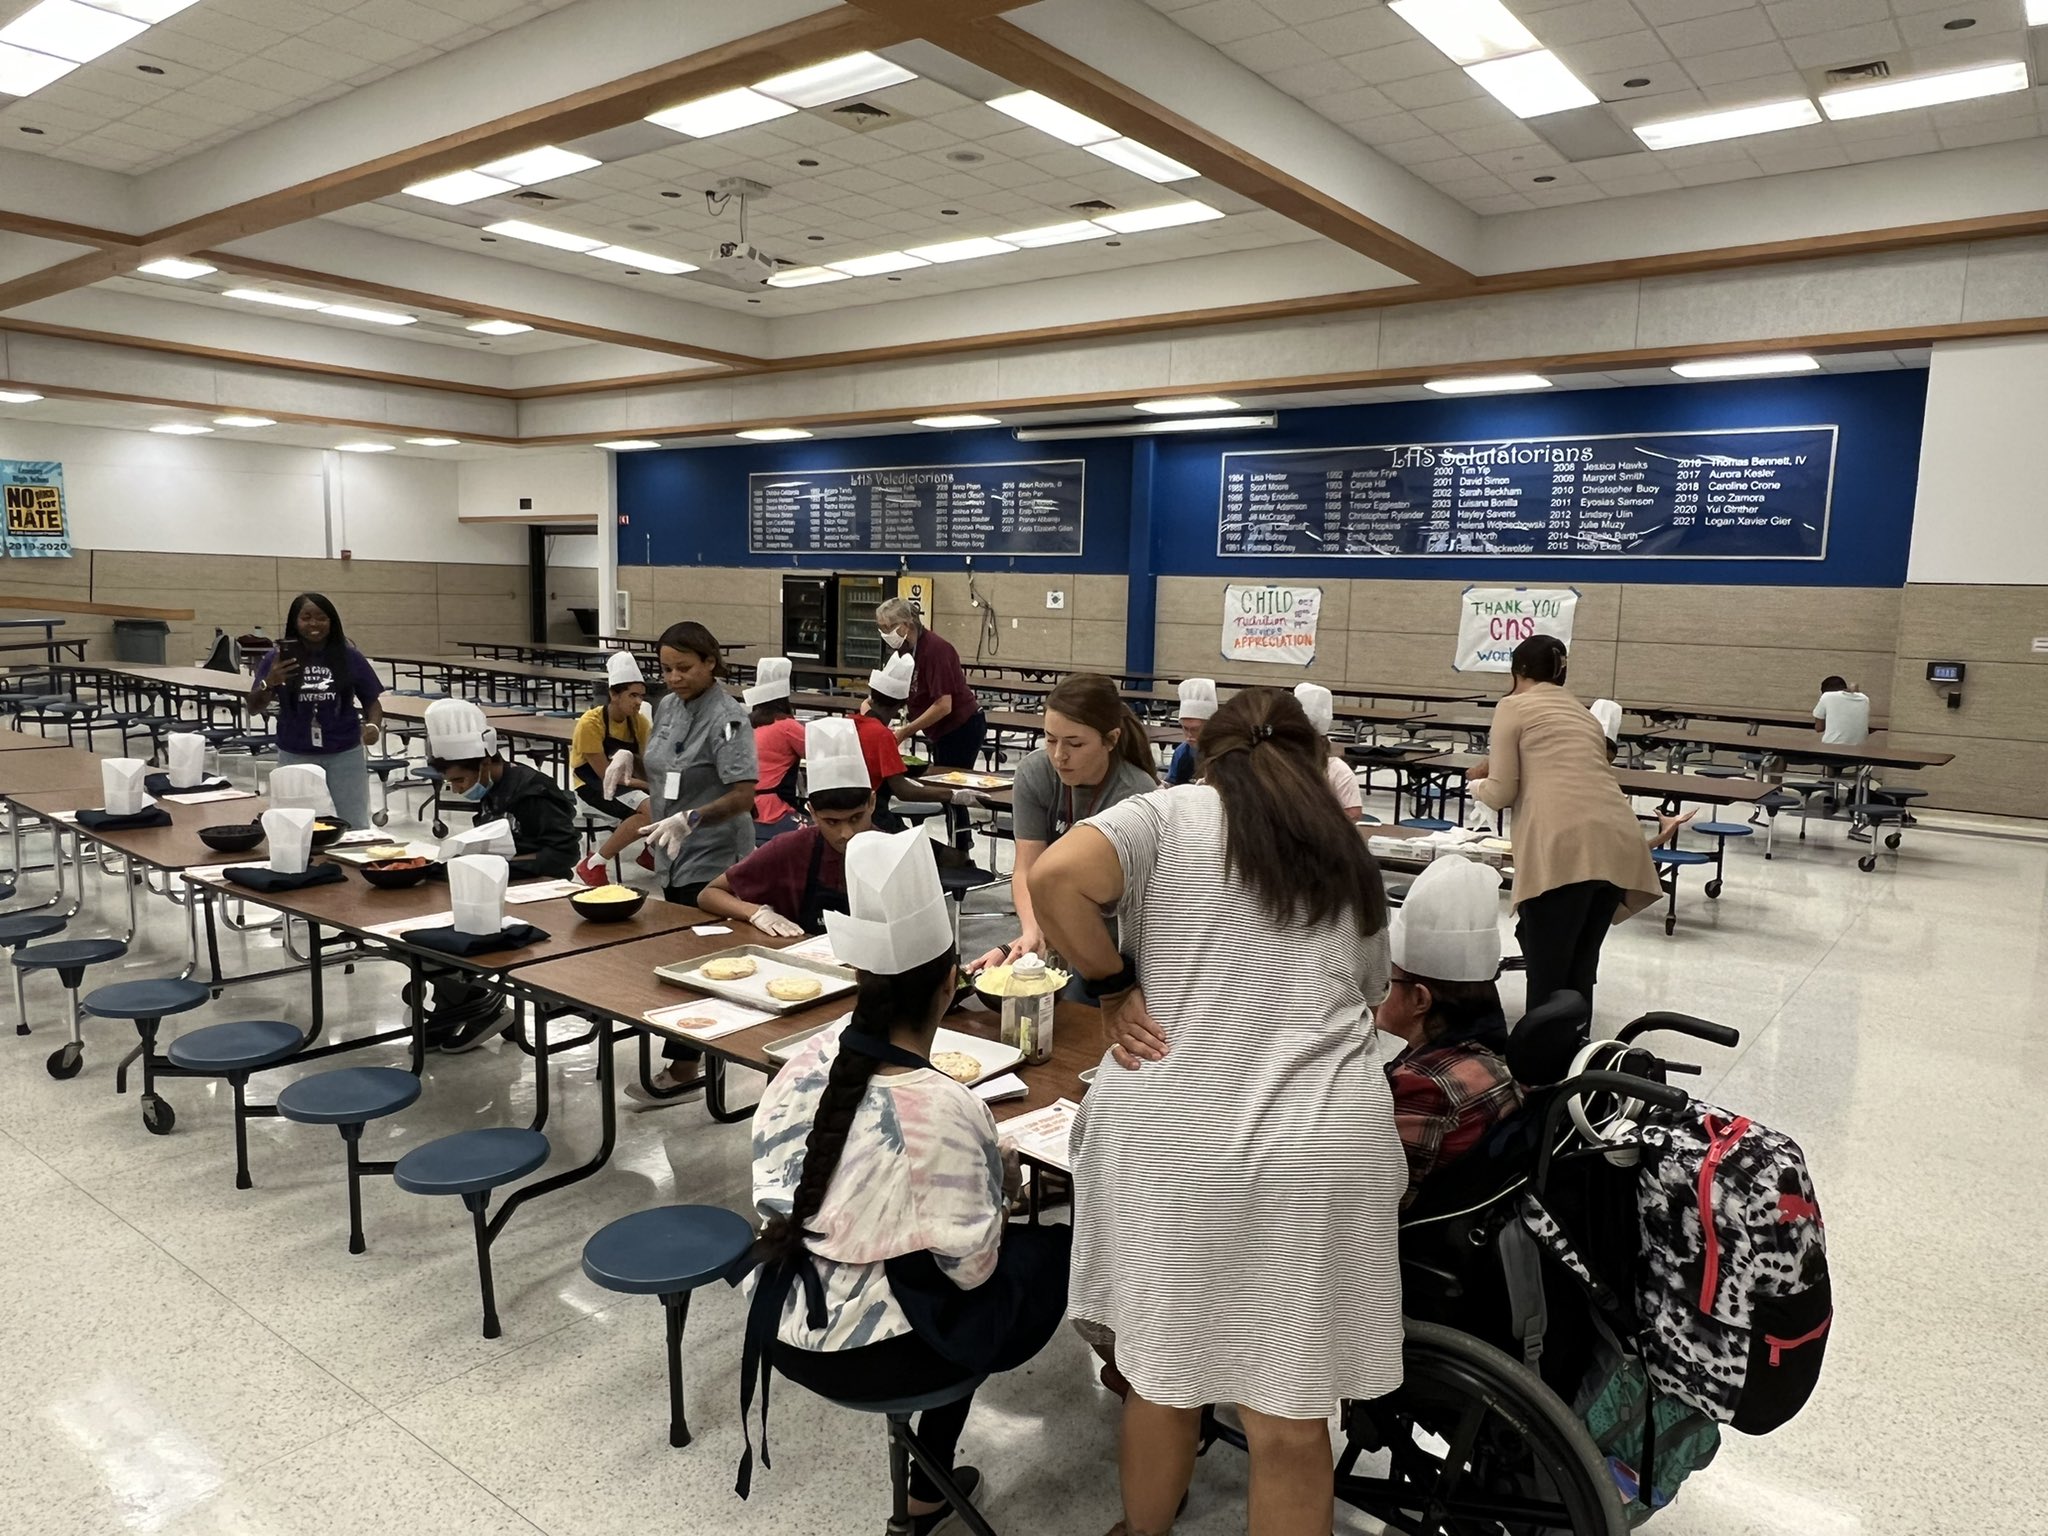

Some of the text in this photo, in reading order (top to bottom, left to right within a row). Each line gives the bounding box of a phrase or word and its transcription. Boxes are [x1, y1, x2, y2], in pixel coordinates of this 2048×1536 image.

[1392, 445, 1594, 468] LHS Salutatorians
[1553, 461, 1648, 472] 2008 Jessica Hawks
[1678, 456, 1807, 468] 2016 Thomas Bennett, IV
[1381, 469, 1398, 479] Frye
[1434, 466, 1491, 476] 2000 Tim Yip
[1677, 471, 1700, 480] 2017
[1709, 470, 1741, 479] Aurora
[876, 472, 954, 485] Valedictorians
[1251, 474, 1264, 482] Lisa
[1433, 476, 1510, 486] 2001 David Simon
[1552, 472, 1645, 483] 2009 Margret Smith
[1552, 486, 1574, 495] 2010
[1582, 485, 1633, 494] Christopher
[1676, 481, 1781, 491] 2018 Caroline Crone
[1432, 487, 1522, 497] 2002 Sarah Beckham
[7, 487, 34, 508] NO
[1550, 499, 1571, 507] 2011
[1617, 497, 1654, 506] Samson
[1675, 493, 1765, 503] 2019 Leo Zamora
[1432, 499, 1451, 508] 2003
[1491, 498, 1518, 507] Bonilla
[1674, 505, 1697, 514] 2020
[9, 509, 60, 528] HATE
[1348, 512, 1390, 520] Christopher
[1431, 510, 1451, 519] 2004
[1457, 510, 1485, 520] Hayley
[1550, 510, 1571, 519] 2012
[1579, 510, 1613, 520] Lindsey
[1456, 521, 1485, 529] Helena
[1549, 520, 1625, 530] 2013 Julie Muzy
[1673, 516, 1792, 527] 2021 Logan Xavier Gier
[1475, 532, 1498, 540] North
[1548, 532, 1569, 540] 2014
[1614, 531, 1638, 540] Barth
[1547, 542, 1568, 550] 2015
[1577, 542, 1599, 552] Holly
[1241, 591, 1293, 614] CHILD
[1471, 599, 1560, 618] THANK YOU
[1234, 634, 1313, 648] APPRECIATION
